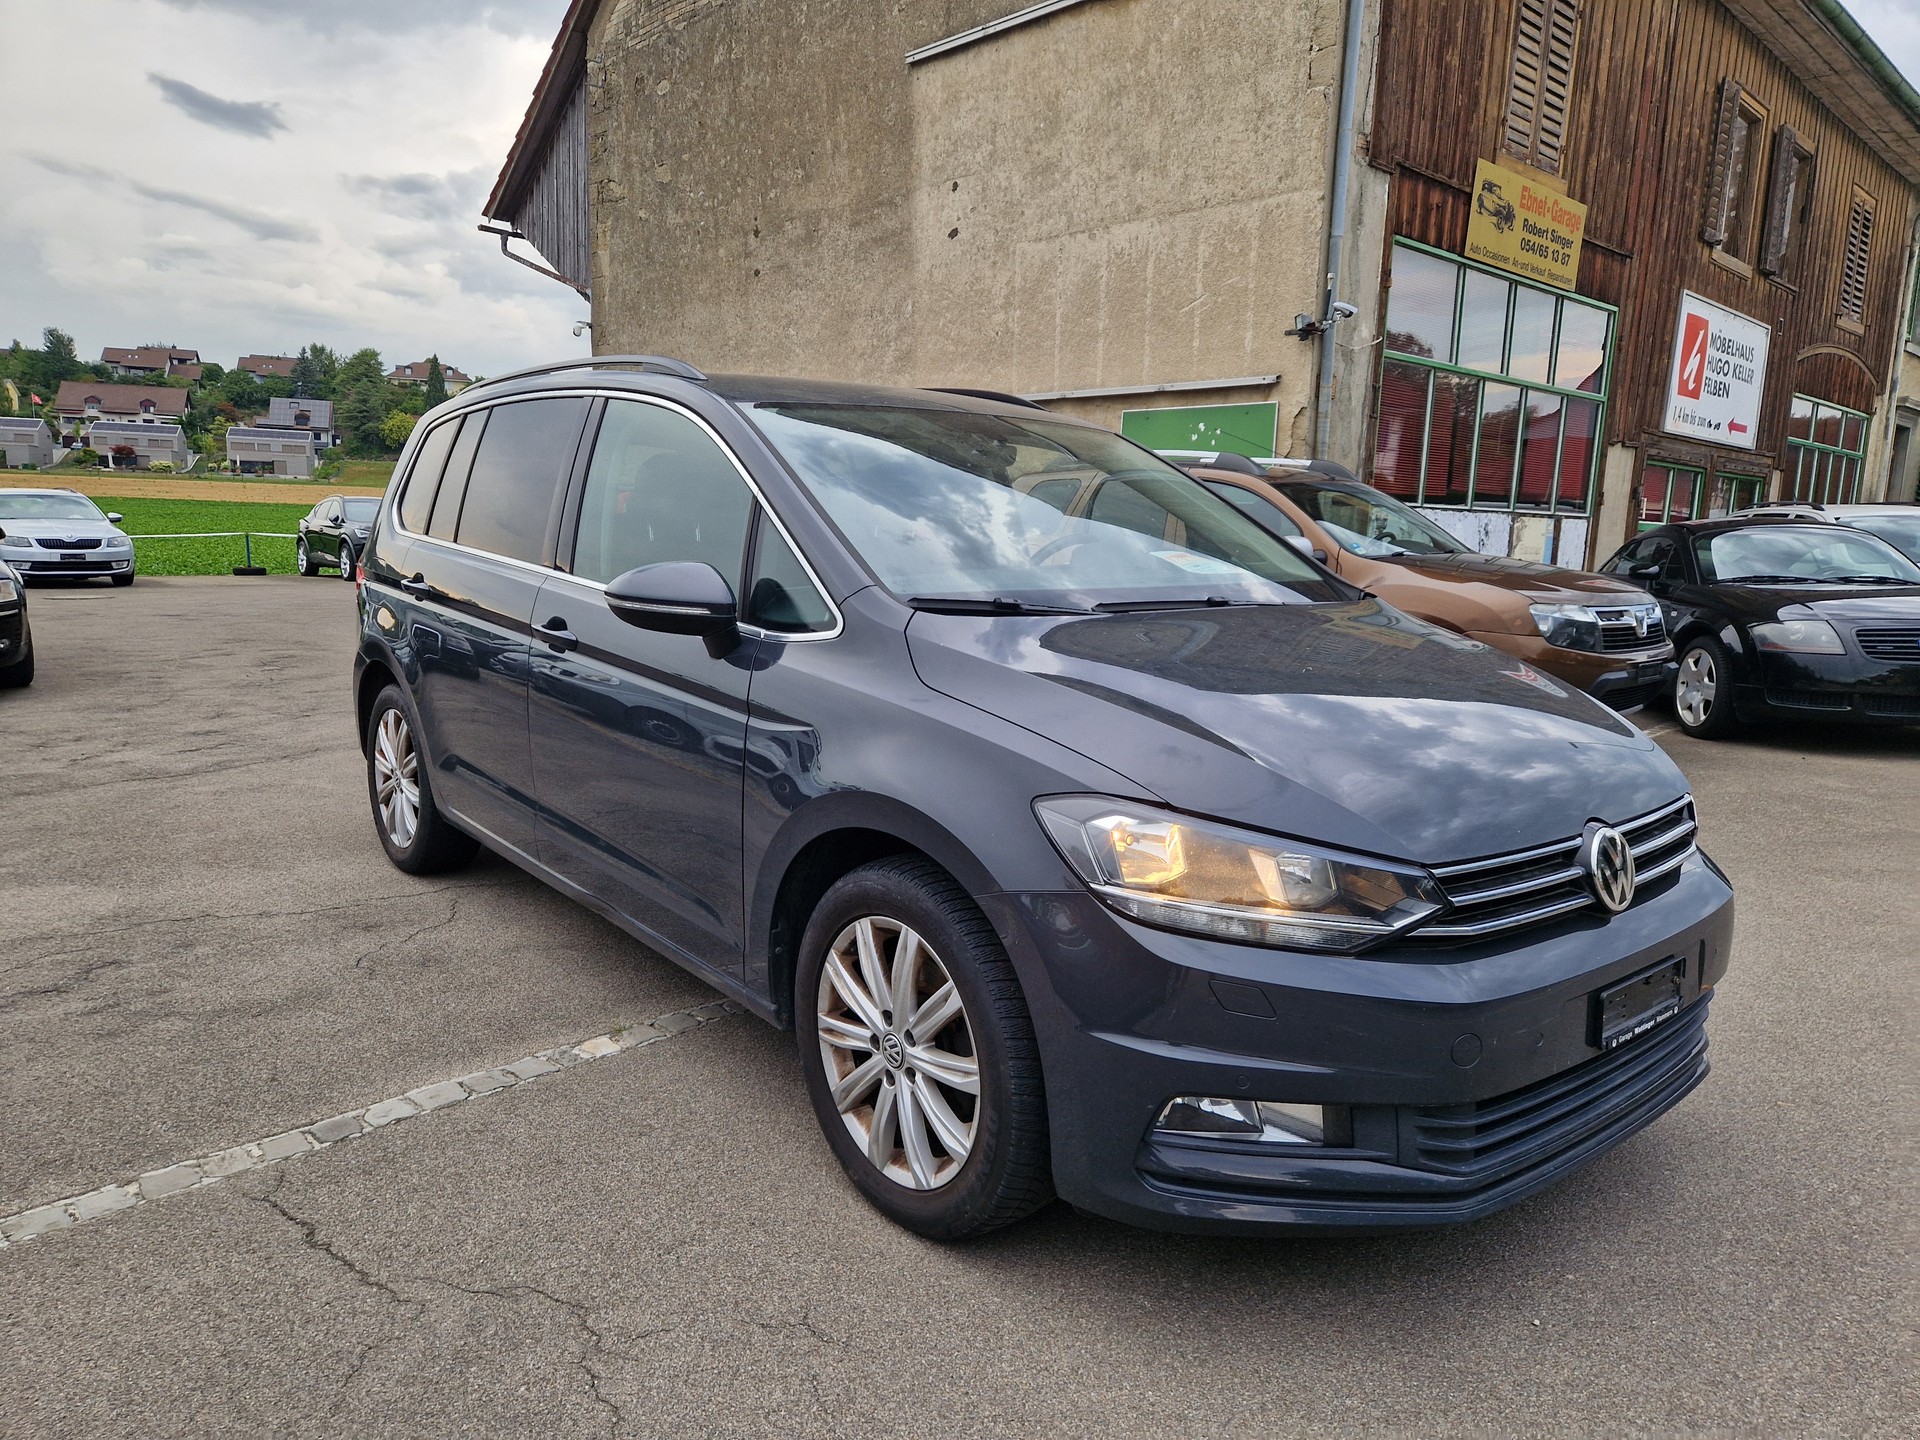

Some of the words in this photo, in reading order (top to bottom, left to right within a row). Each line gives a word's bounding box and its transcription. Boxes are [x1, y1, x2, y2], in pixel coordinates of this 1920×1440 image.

[1520, 185, 1581, 234] Ebnet-Garage
[1523, 218, 1549, 240] Robert
[1550, 229, 1574, 249] Singer
[1470, 242, 1481, 254] Auto
[1482, 247, 1510, 265] Occasionen
[1530, 262, 1546, 276] Verkauf
[1547, 269, 1573, 286] Reparaturen
[1521, 238, 1548, 259] 054/65
[1552, 249, 1559, 263] 13
[1561, 253, 1571, 266] 87
[1709, 330, 1754, 363] MÖBELHAUS
[1706, 354, 1730, 377] HUGO
[1732, 363, 1754, 385] KELLER
[1703, 377, 1730, 399] FELBEN
[1673, 405, 1682, 423] 1,4
[1682, 407, 1689, 424] km
[1697, 416, 1707, 427] zum
